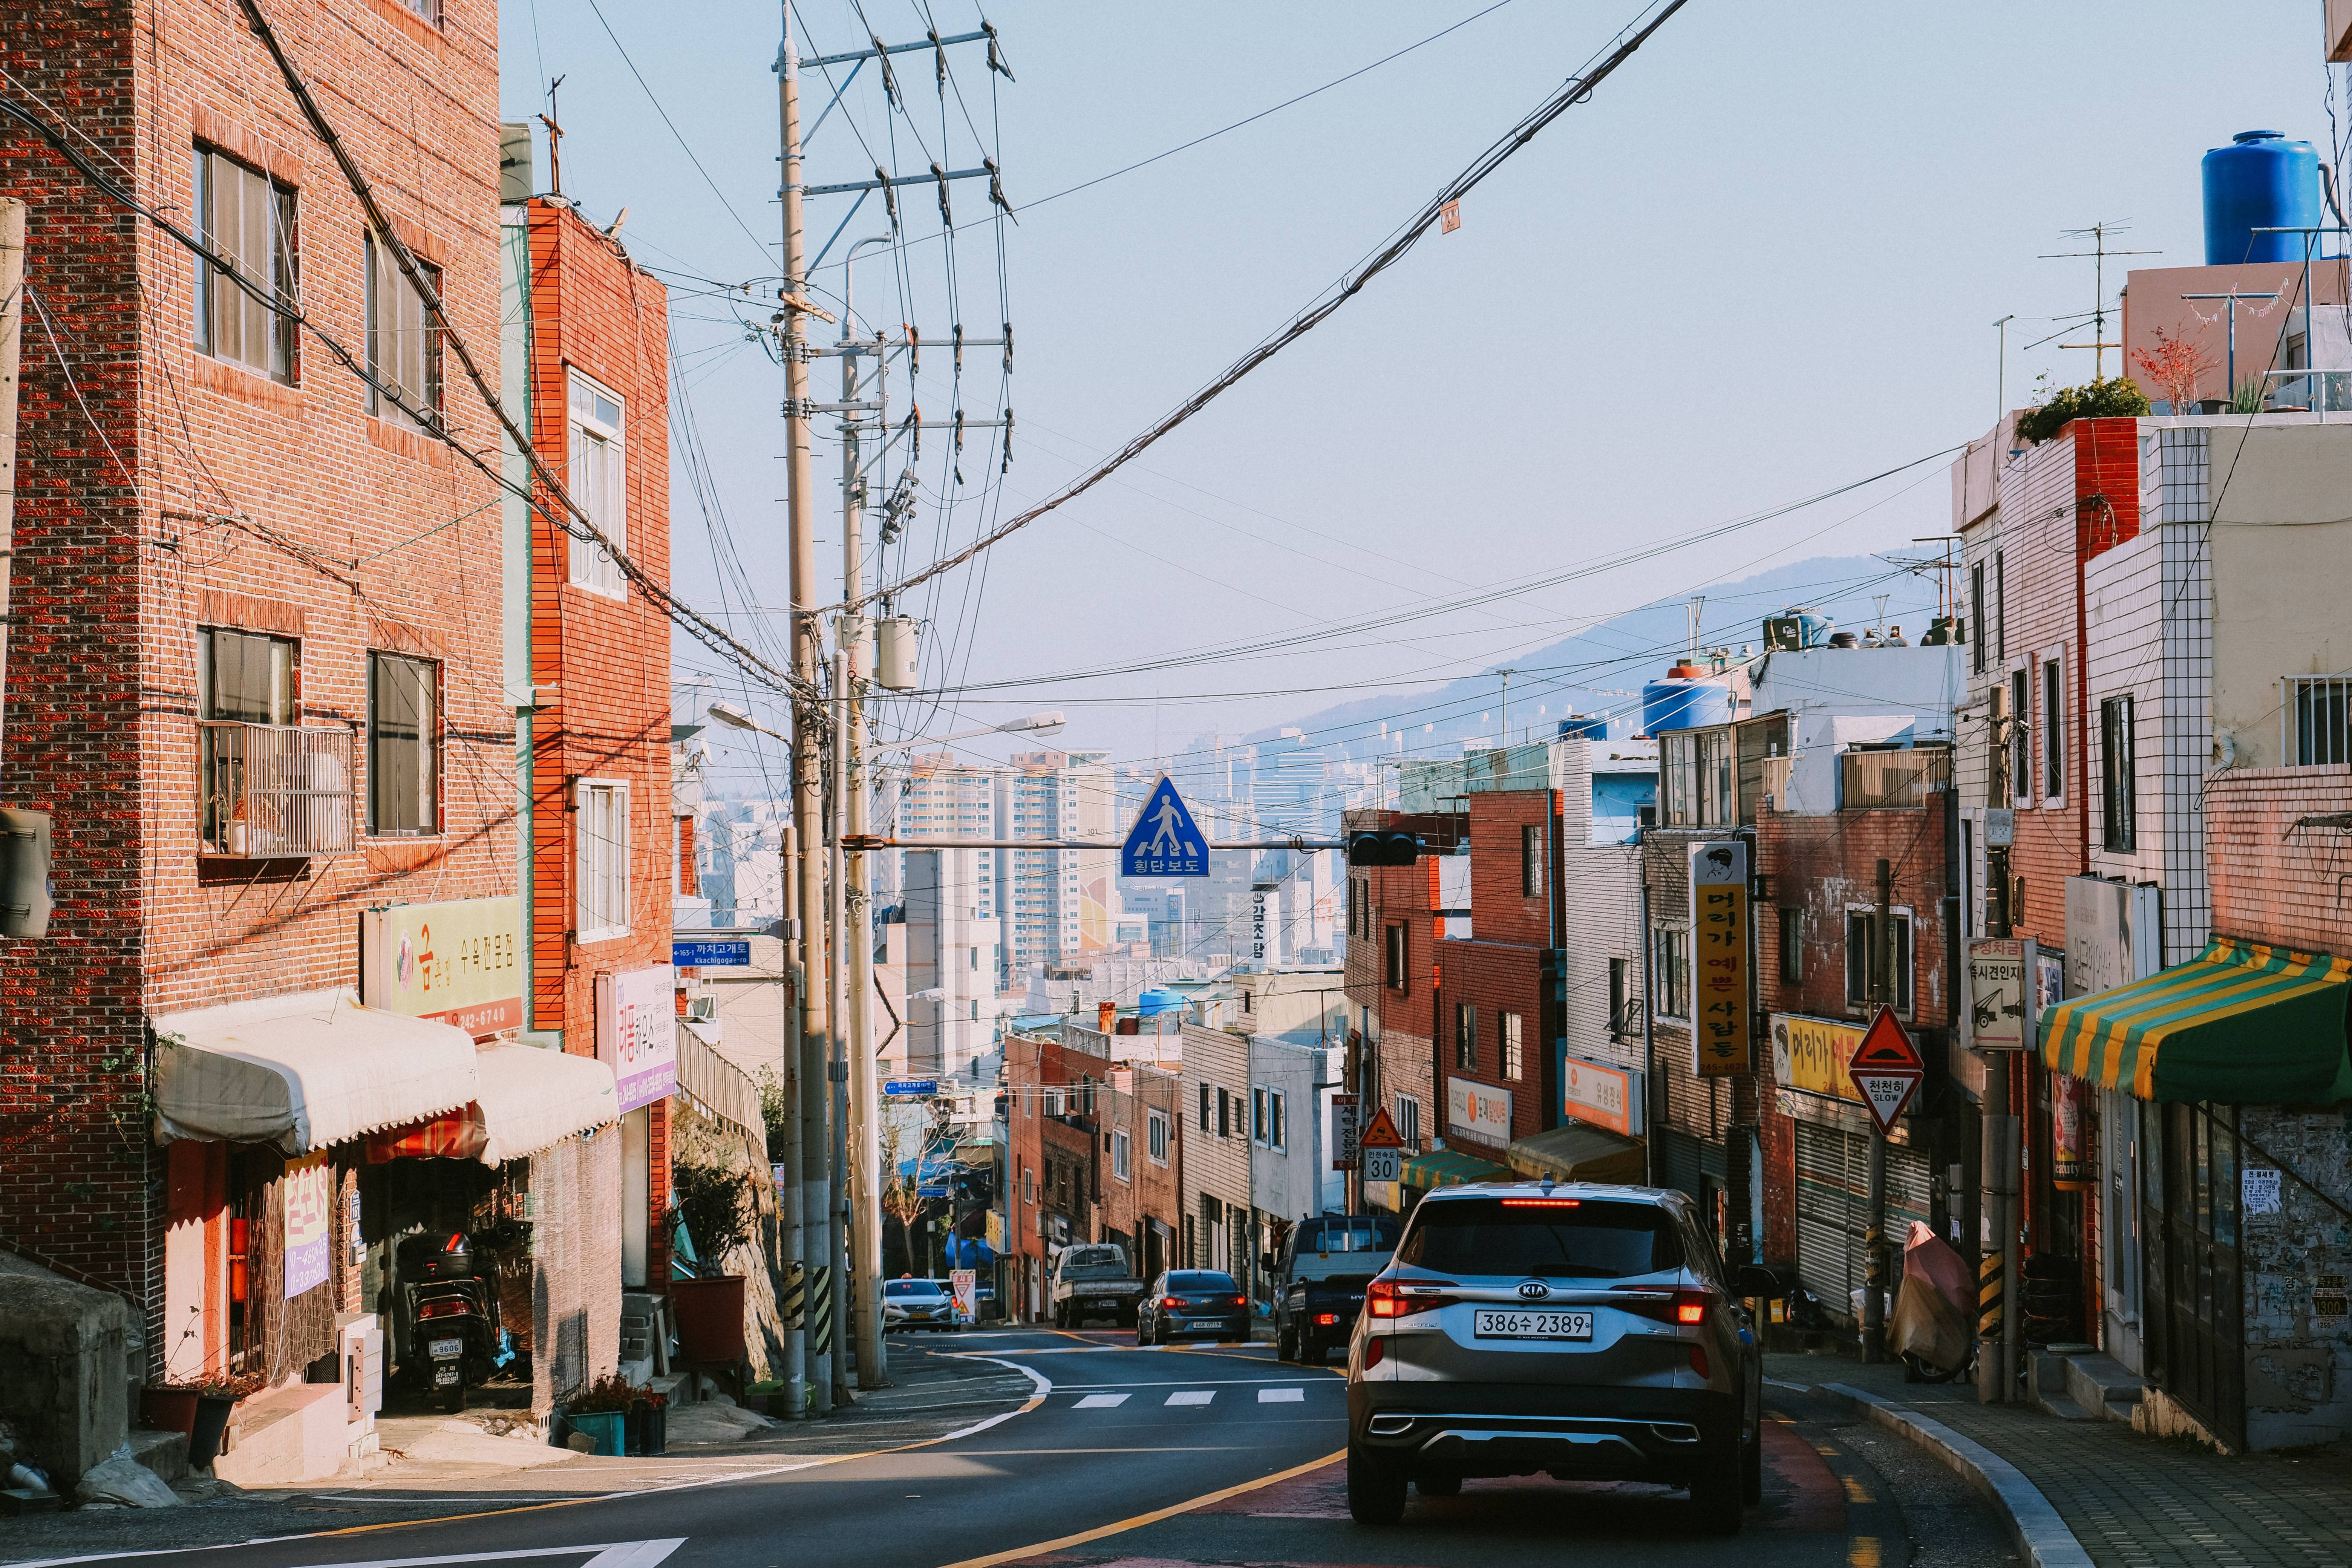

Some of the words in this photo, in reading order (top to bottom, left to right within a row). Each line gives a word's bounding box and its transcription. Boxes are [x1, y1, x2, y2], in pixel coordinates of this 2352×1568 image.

[1134, 860, 1199, 873] 횡단보도
[1707, 892, 1736, 946] 머리가
[419, 924, 450, 994] 금촌집
[461, 933, 512, 974] 수육전문점
[697, 944, 746, 954] 까치고개로
[1707, 956, 1738, 992] 예쁜
[1971, 965, 2025, 980] 즉시견인지
[460, 1007, 504, 1029] 242-6740
[1707, 1001, 1739, 1057] 사람들
[1793, 1027, 1828, 1075] 머리가
[1700, 1063, 1747, 1072] 245-4628
[1597, 1083, 1621, 1110] 유성장식
[1823, 1081, 1861, 1097] 245-462
[1870, 1080, 1903, 1093] 천천히
[1341, 1106, 1358, 1160] 세탁전문점
[1371, 1160, 1392, 1178] 30
[2055, 1164, 2080, 1177] eauty
[1523, 1286, 1544, 1295] KIA
[1483, 1314, 1531, 1332] 386수
[1536, 1315, 1584, 1334] 2389
